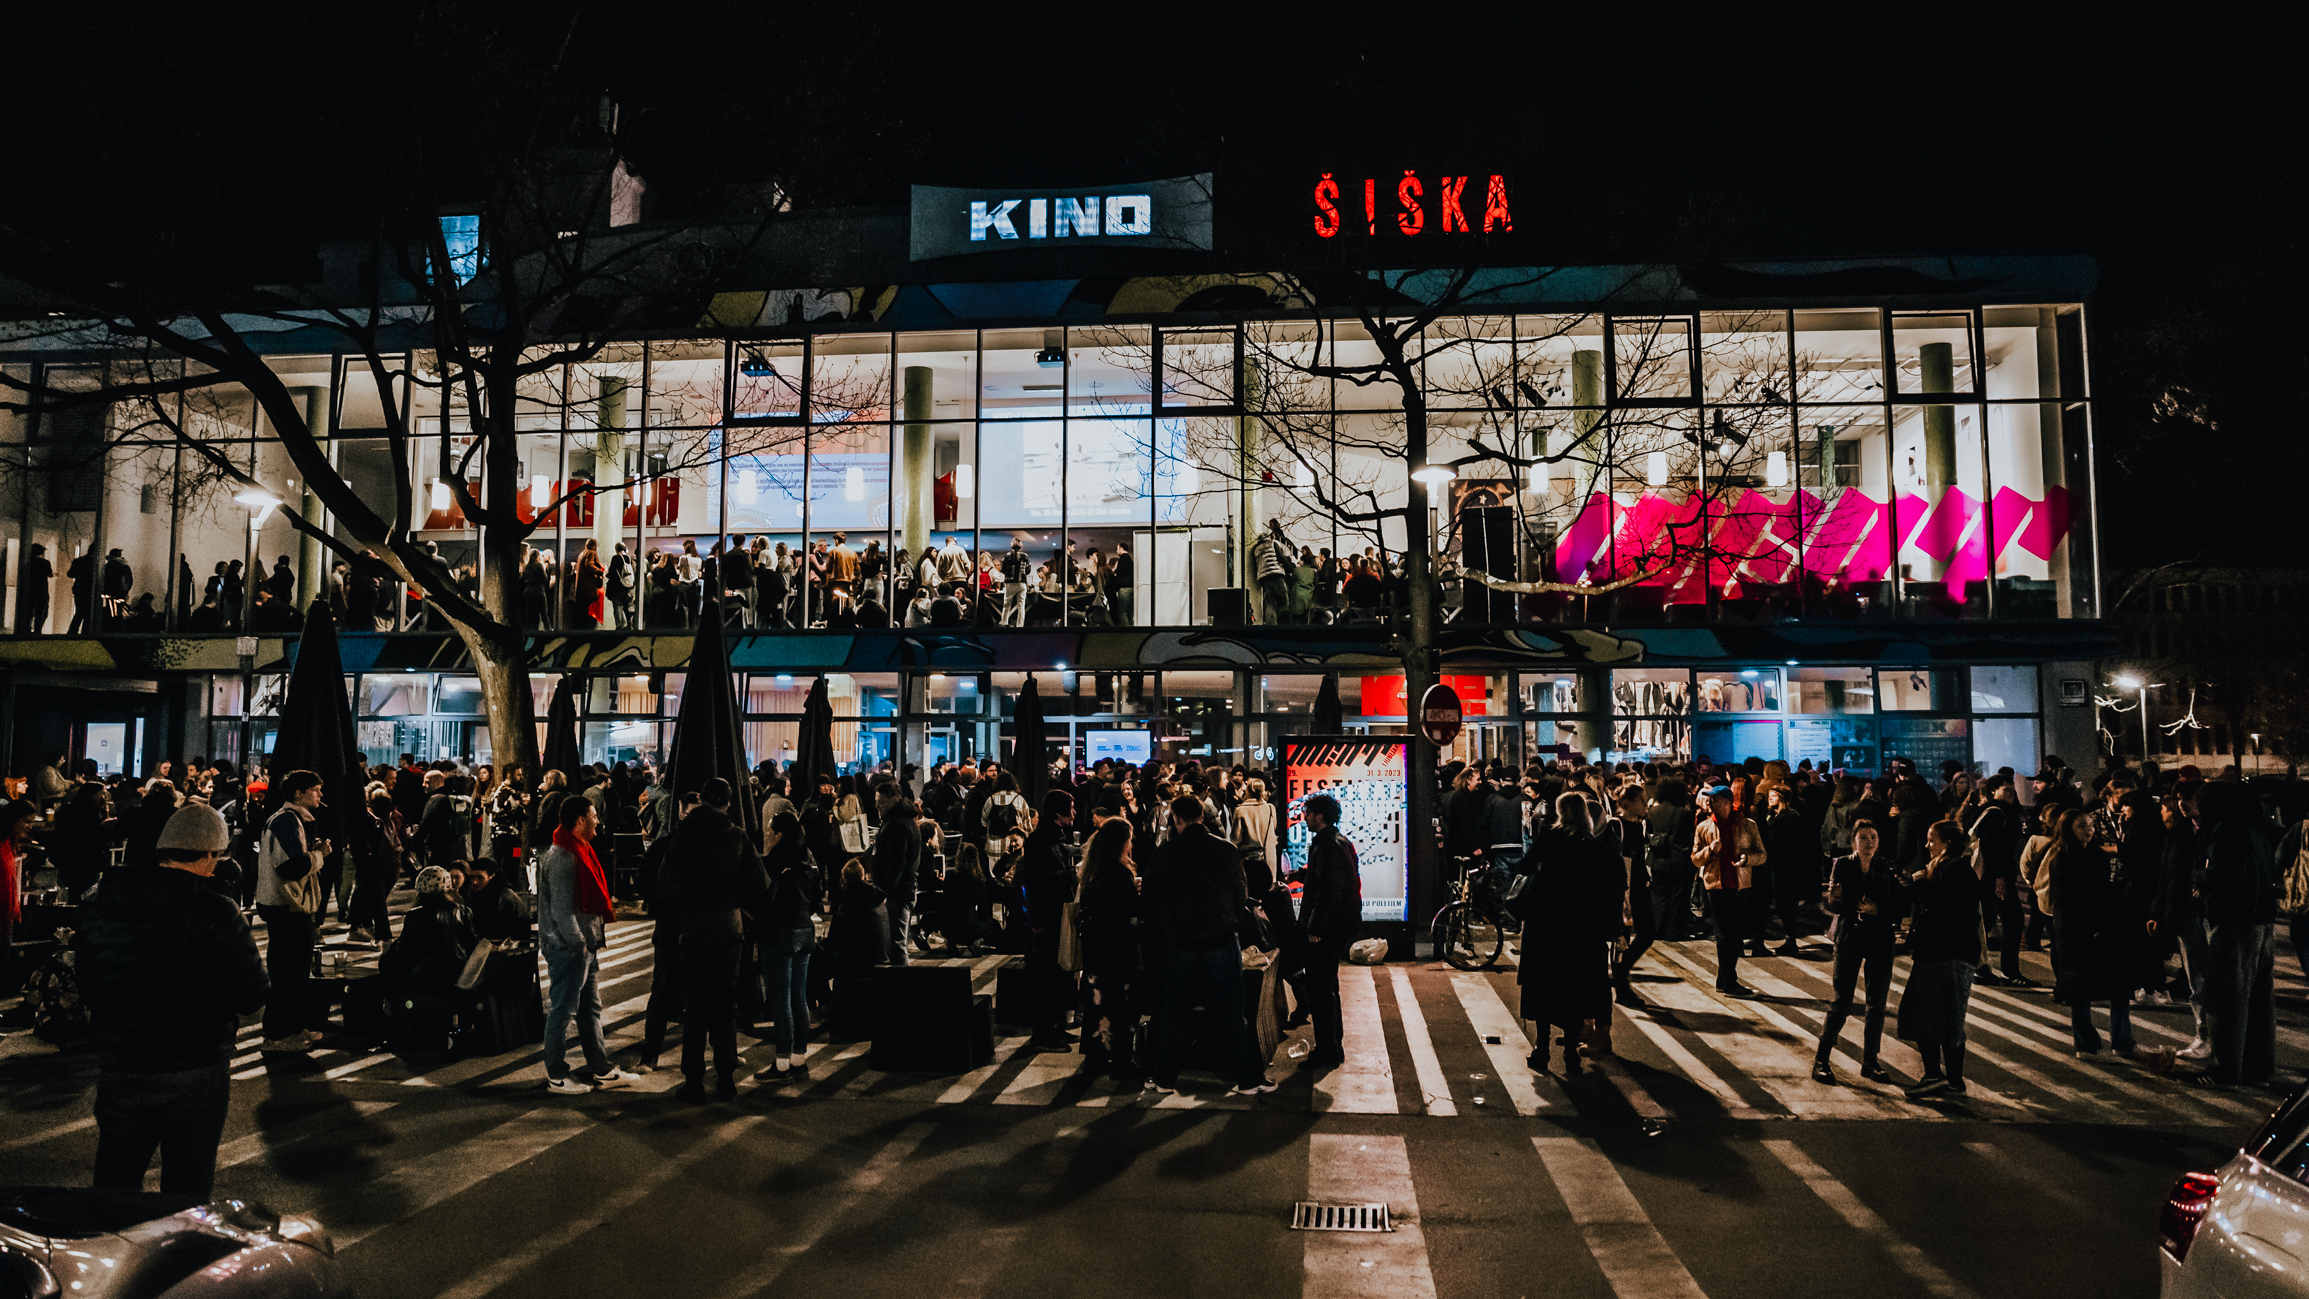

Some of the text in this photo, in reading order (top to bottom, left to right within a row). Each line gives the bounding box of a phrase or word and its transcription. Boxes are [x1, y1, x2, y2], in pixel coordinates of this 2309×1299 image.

[969, 169, 1513, 242] KINO ŠIŠKA
[1384, 769, 1401, 777] 2023
